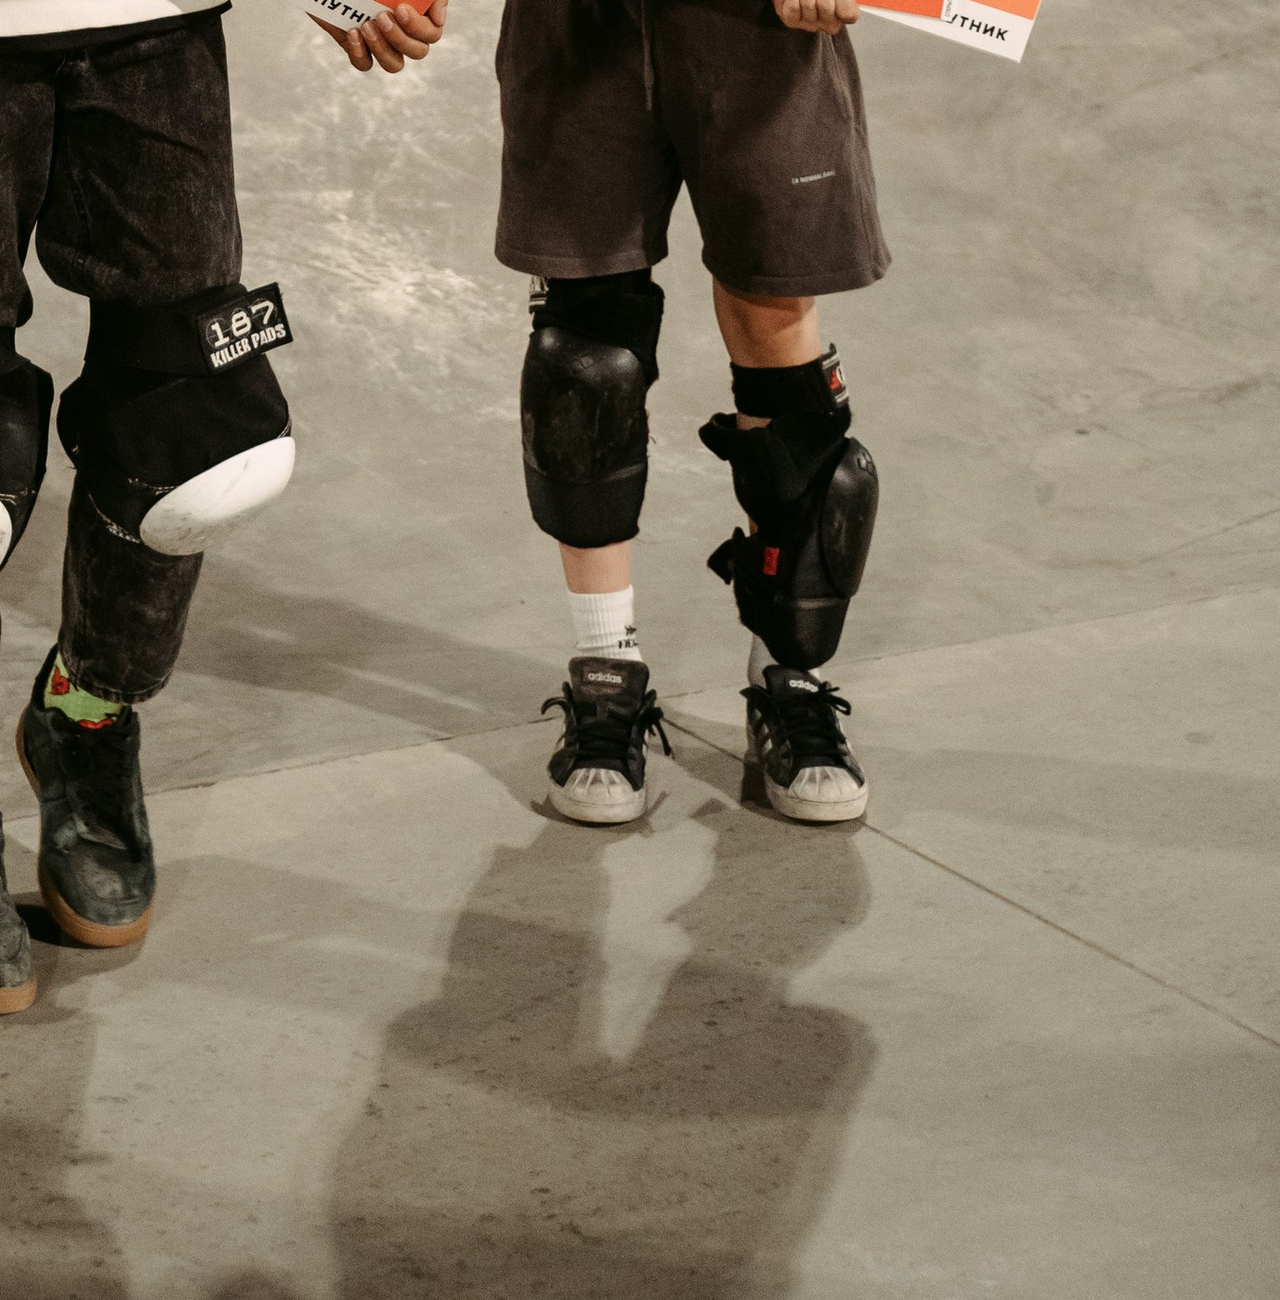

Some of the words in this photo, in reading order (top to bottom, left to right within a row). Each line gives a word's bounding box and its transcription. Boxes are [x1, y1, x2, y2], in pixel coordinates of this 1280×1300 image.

[210, 337, 252, 368] KILLER
[251, 323, 287, 349] PADS
[211, 300, 274, 348] 187
[587, 670, 623, 685] adidas
